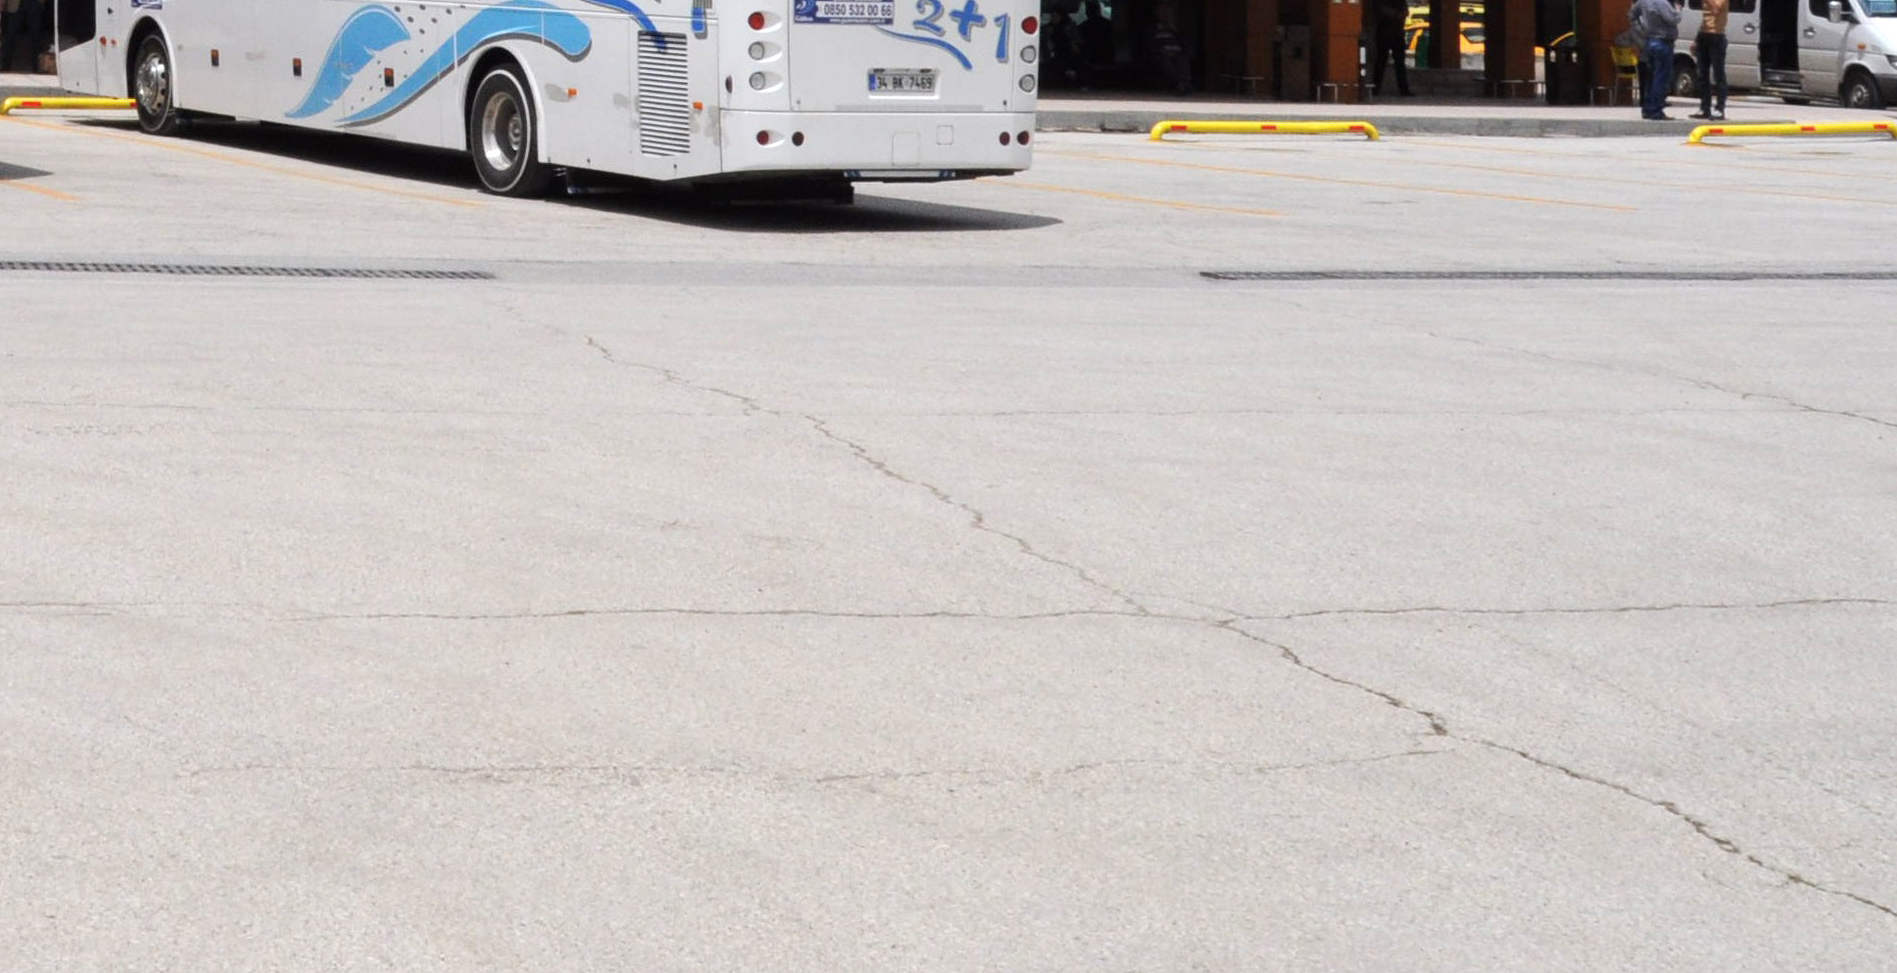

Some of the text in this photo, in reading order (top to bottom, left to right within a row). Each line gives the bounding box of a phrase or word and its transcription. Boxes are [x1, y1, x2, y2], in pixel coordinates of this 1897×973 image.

[823, 3, 892, 16] 0850 532 00 66
[877, 76, 888, 89] 34
